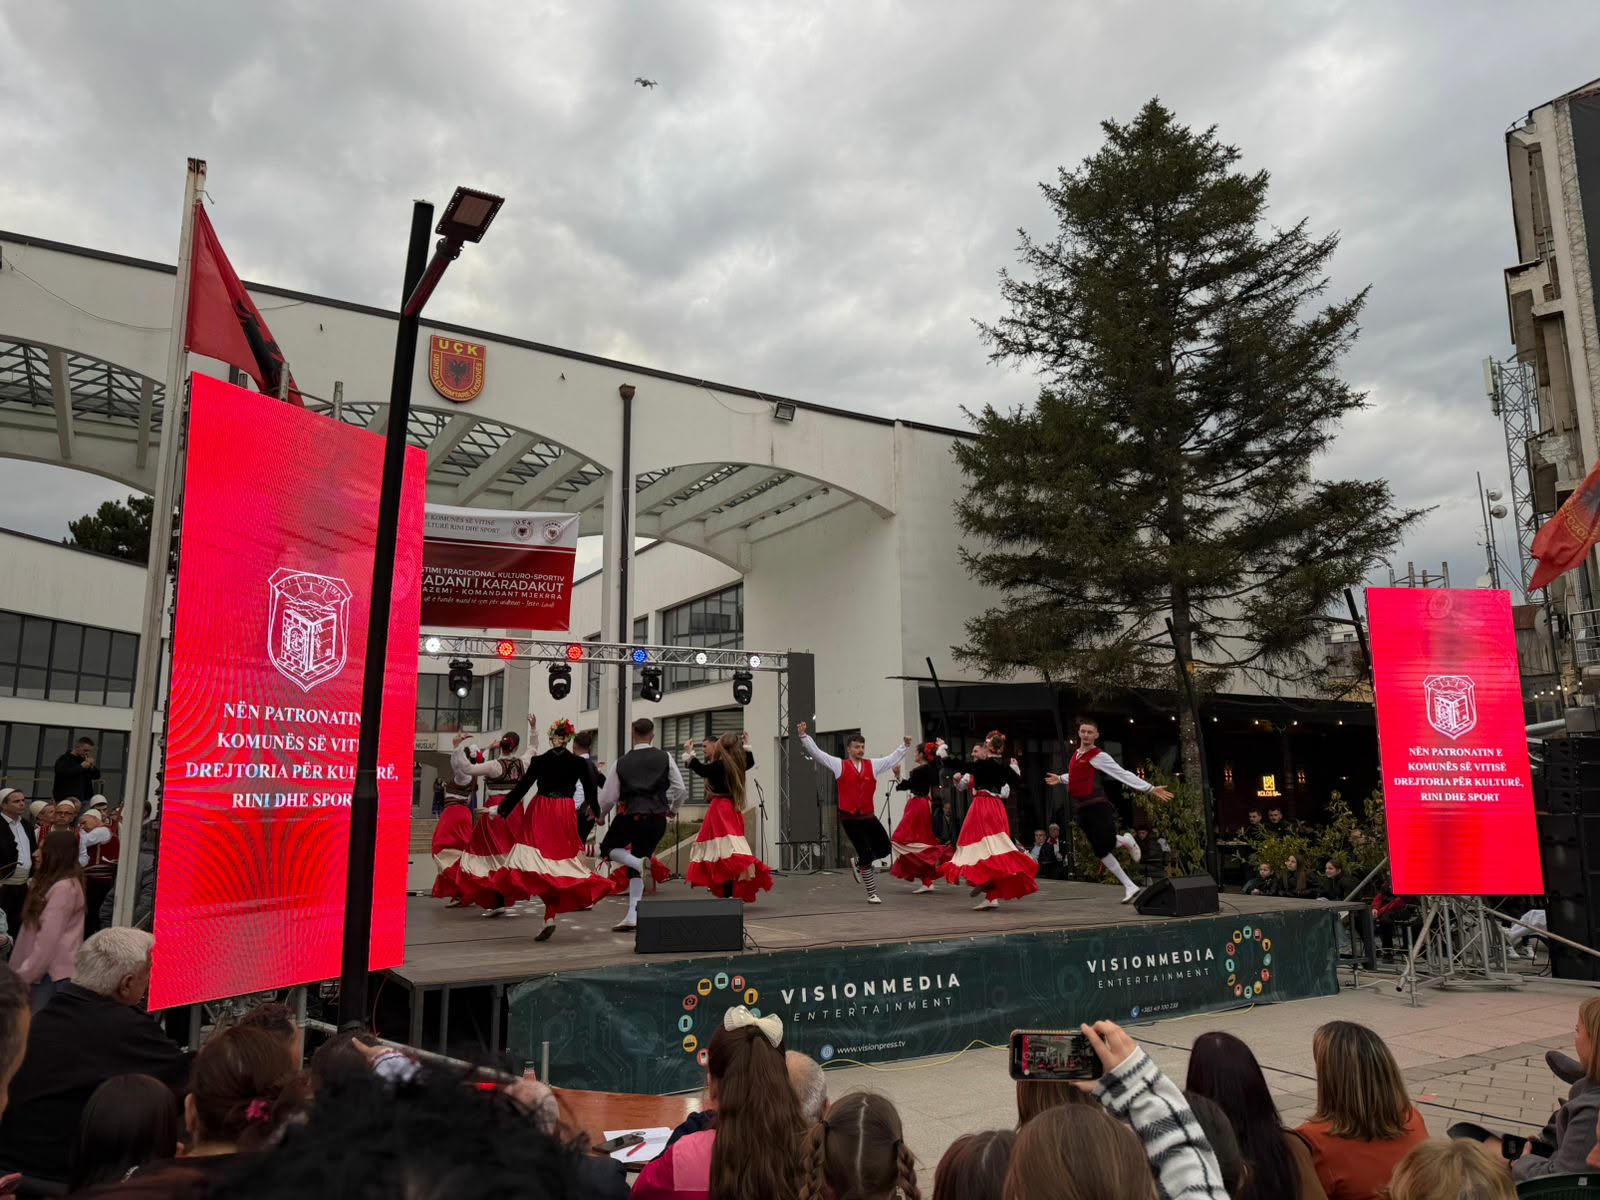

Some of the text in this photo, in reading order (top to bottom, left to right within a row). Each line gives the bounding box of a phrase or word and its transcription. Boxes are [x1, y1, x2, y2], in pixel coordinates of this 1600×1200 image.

[438, 338, 478, 356] UÇK
[421, 574, 564, 593] ADANI I KARADAKUT
[443, 568, 496, 578] TRADICIONAL
[498, 572, 564, 582] KULTURO-SPORTIV
[462, 588, 518, 597] KOMANDANT
[521, 592, 562, 600] MJEKRRA
[223, 701, 362, 726] NËN PATRONATIN
[217, 732, 305, 751] KOMUNËS
[308, 734, 327, 752] SË
[1408, 746, 1504, 757] NËN PATRONATIN E
[185, 762, 399, 782] DREJTORIA PËR KULRË,
[1408, 761, 1506, 772] KOMUNËS SË VITISË
[1394, 776, 1524, 788] DREJTORIA PËR KULTURË,
[231, 793, 352, 809] RINI DHE SPOR
[1421, 792, 1500, 802] RINI DHE SPORT
[1087, 948, 1215, 974] VISIONMEDIA
[1098, 967, 1210, 989] ENTERTAINMENT
[780, 973, 961, 1005] VISIONMEDIA
[793, 996, 953, 1023] ENTERTAINMENT
[836, 1040, 906, 1055] www.visionpress.tv
